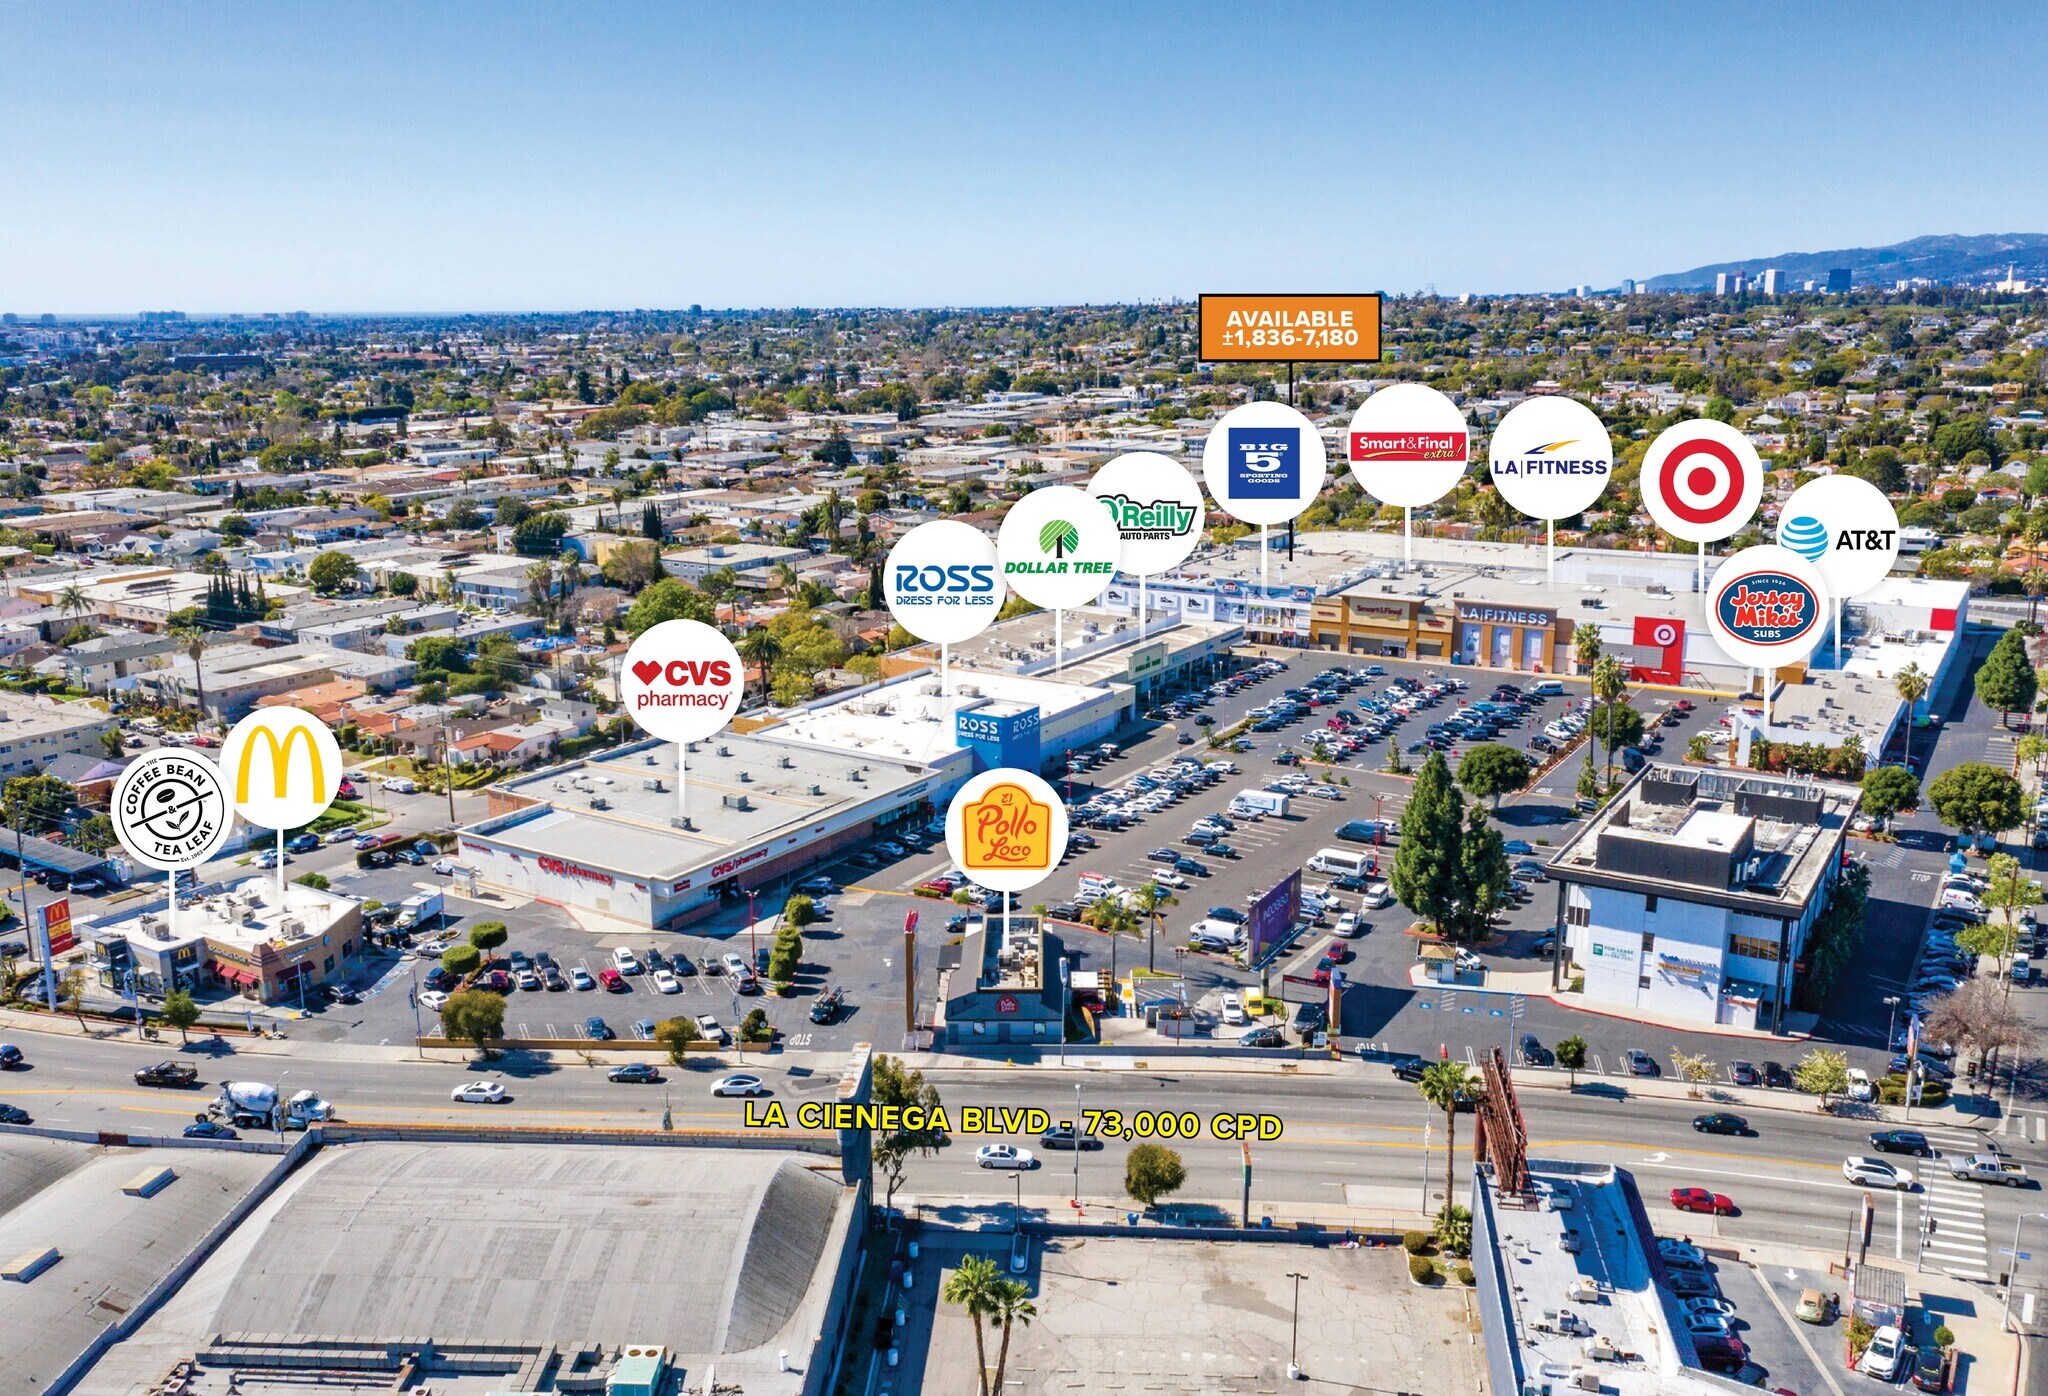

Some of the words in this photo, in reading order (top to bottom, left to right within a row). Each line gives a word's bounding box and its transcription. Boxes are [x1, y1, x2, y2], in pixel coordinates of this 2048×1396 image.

[959, 716, 998, 735] ROSS
[1013, 712, 1040, 733] ROSS
[957, 730, 974, 738] DRESS
[987, 735, 1000, 743] LESS
[1910, 873, 1932, 882] STOP
[1616, 947, 1634, 955] LEASE
[789, 1033, 812, 1046] STOP
[1355, 1042, 1377, 1054] STOP
